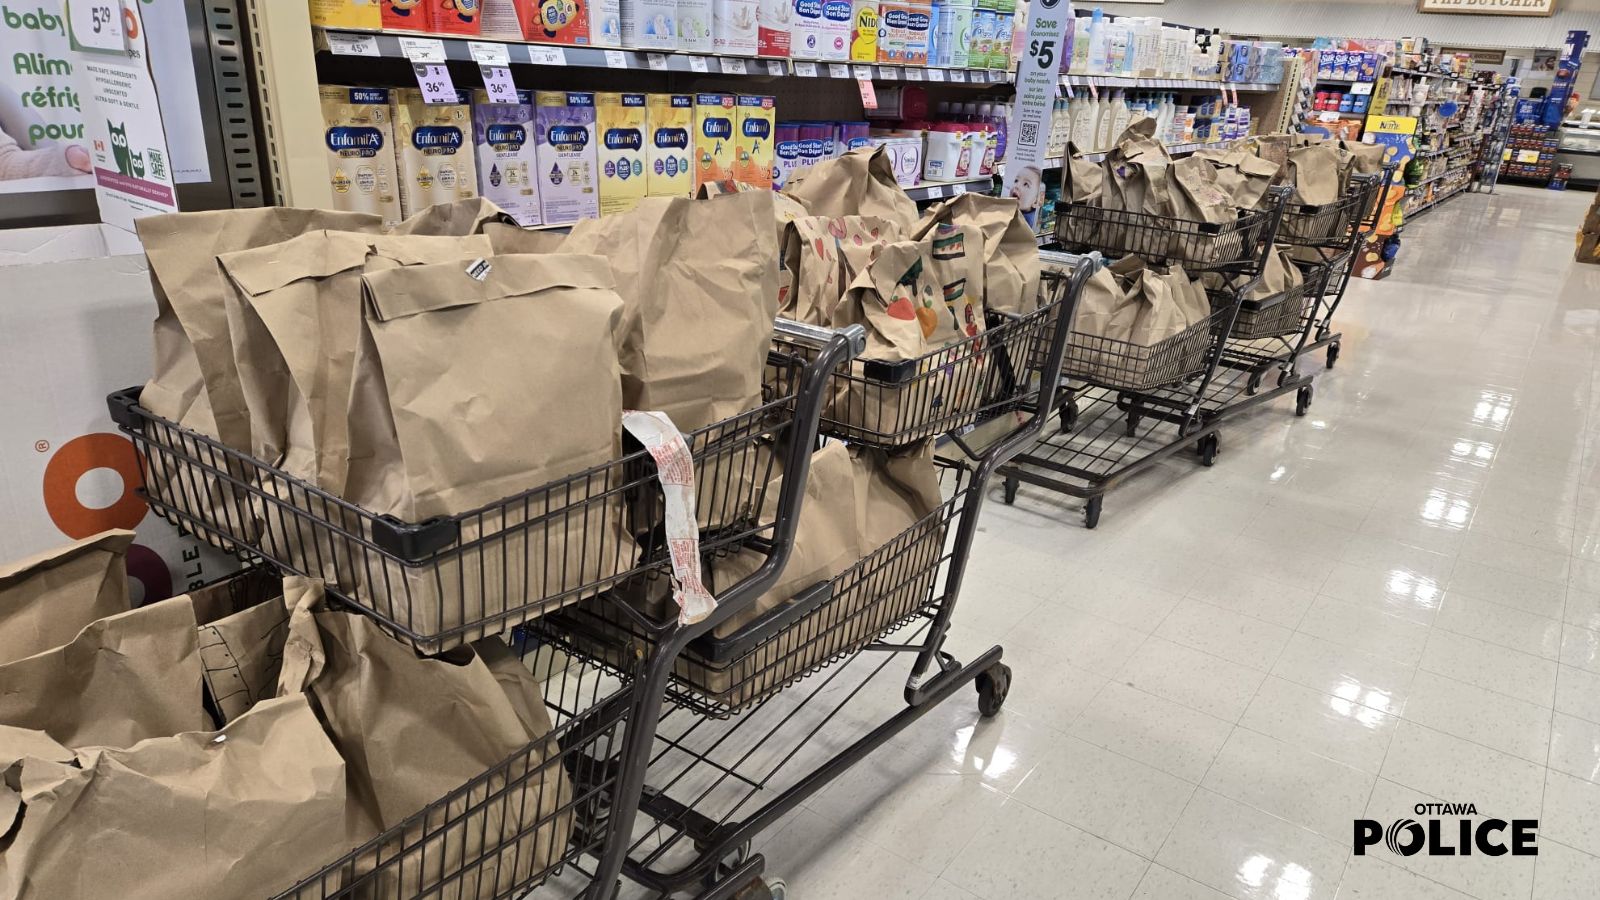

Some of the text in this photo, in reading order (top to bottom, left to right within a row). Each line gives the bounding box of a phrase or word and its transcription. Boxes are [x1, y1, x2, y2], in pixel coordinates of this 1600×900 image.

[2, 6, 65, 37] baby
[859, 15, 877, 28] NID
[1036, 18, 1057, 29] Save
[13, 52, 73, 76] Alim
[706, 121, 729, 133] Enfamil
[746, 121, 768, 133] Enfamil
[29, 123, 84, 145] pour
[331, 132, 369, 146] Enfamil
[416, 132, 449, 145] Enfamil
[489, 129, 514, 141] Enfamil
[551, 130, 577, 142] Enfamil
